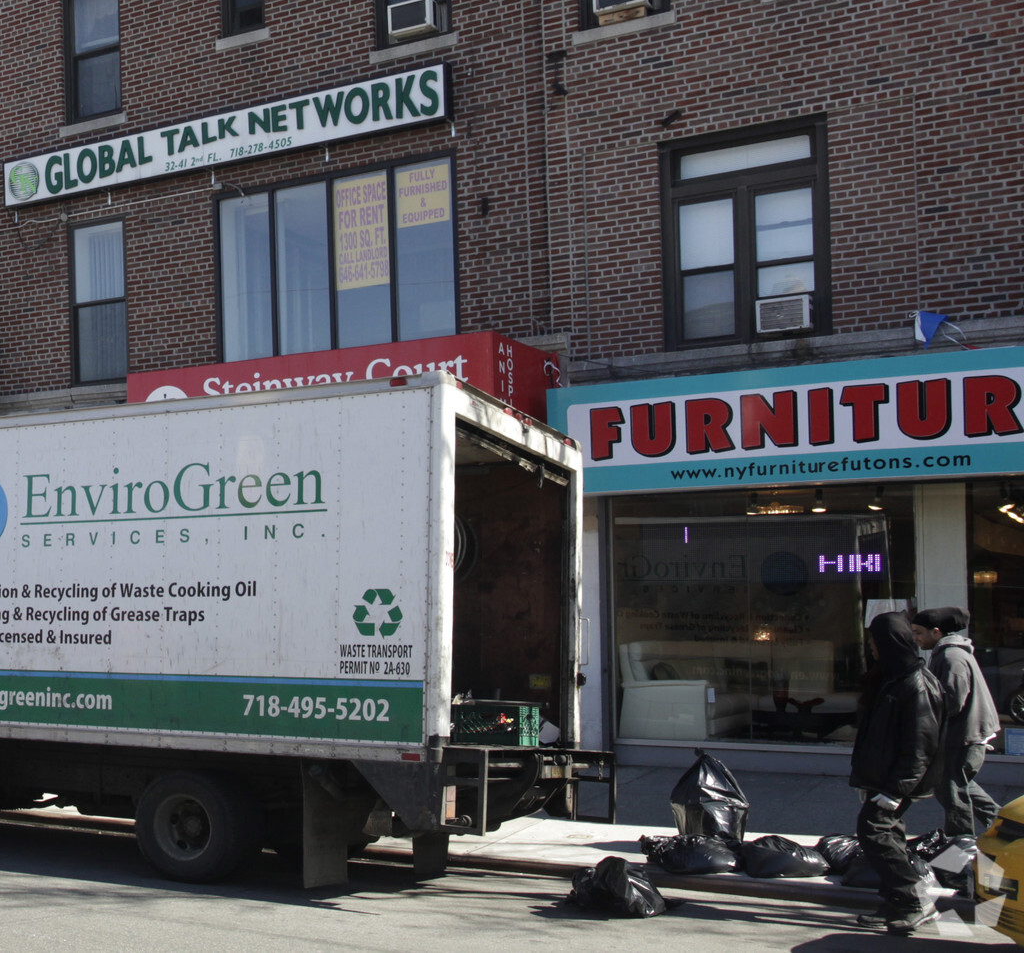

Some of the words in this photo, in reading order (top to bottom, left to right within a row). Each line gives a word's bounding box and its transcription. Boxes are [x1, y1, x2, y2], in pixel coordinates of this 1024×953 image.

[44, 136, 153, 195] GLOBAL
[160, 115, 239, 157] TALK
[247, 69, 439, 136] NETWORKS
[164, 159, 187, 172] 32-41
[207, 152, 222, 163] FL.
[229, 136, 293, 159] 718-278-4505
[409, 168, 435, 183] FULLY
[336, 185, 362, 209] OFFICE
[362, 181, 387, 204] SPACE
[398, 180, 448, 198] FURNISHED
[420, 197, 427, 208] &
[338, 209, 358, 230] FOR
[359, 204, 385, 226] RENT
[402, 207, 445, 224] EQUIPPED
[339, 231, 358, 251] 1300
[670, 452, 972, 481] www.nyfurniturefutons.com
[22, 462, 326, 519] EnviroGreen
[21, 527, 210, 548] SERVICES,
[243, 522, 327, 541] INC.
[21, 583, 31, 598] &
[34, 583, 99, 602] Recycling
[102, 583, 117, 598] of
[120, 582, 165, 598] Waste
[168, 581, 231, 601] Cooking
[235, 580, 257, 597] Oil
[13, 606, 23, 621] &
[26, 606, 89, 625] Recycling
[92, 606, 108, 621] of
[110, 607, 160, 622] Grease
[163, 607, 206, 626] Traps
[46, 629, 57, 644] &
[60, 630, 112, 645] Insured
[339, 644, 366, 658] WASTE
[366, 644, 413, 659] TRANSPORT
[339, 660, 368, 675] PERMIT
[383, 661, 411, 676] 2A-630
[242, 694, 390, 722] 718-495-5202
